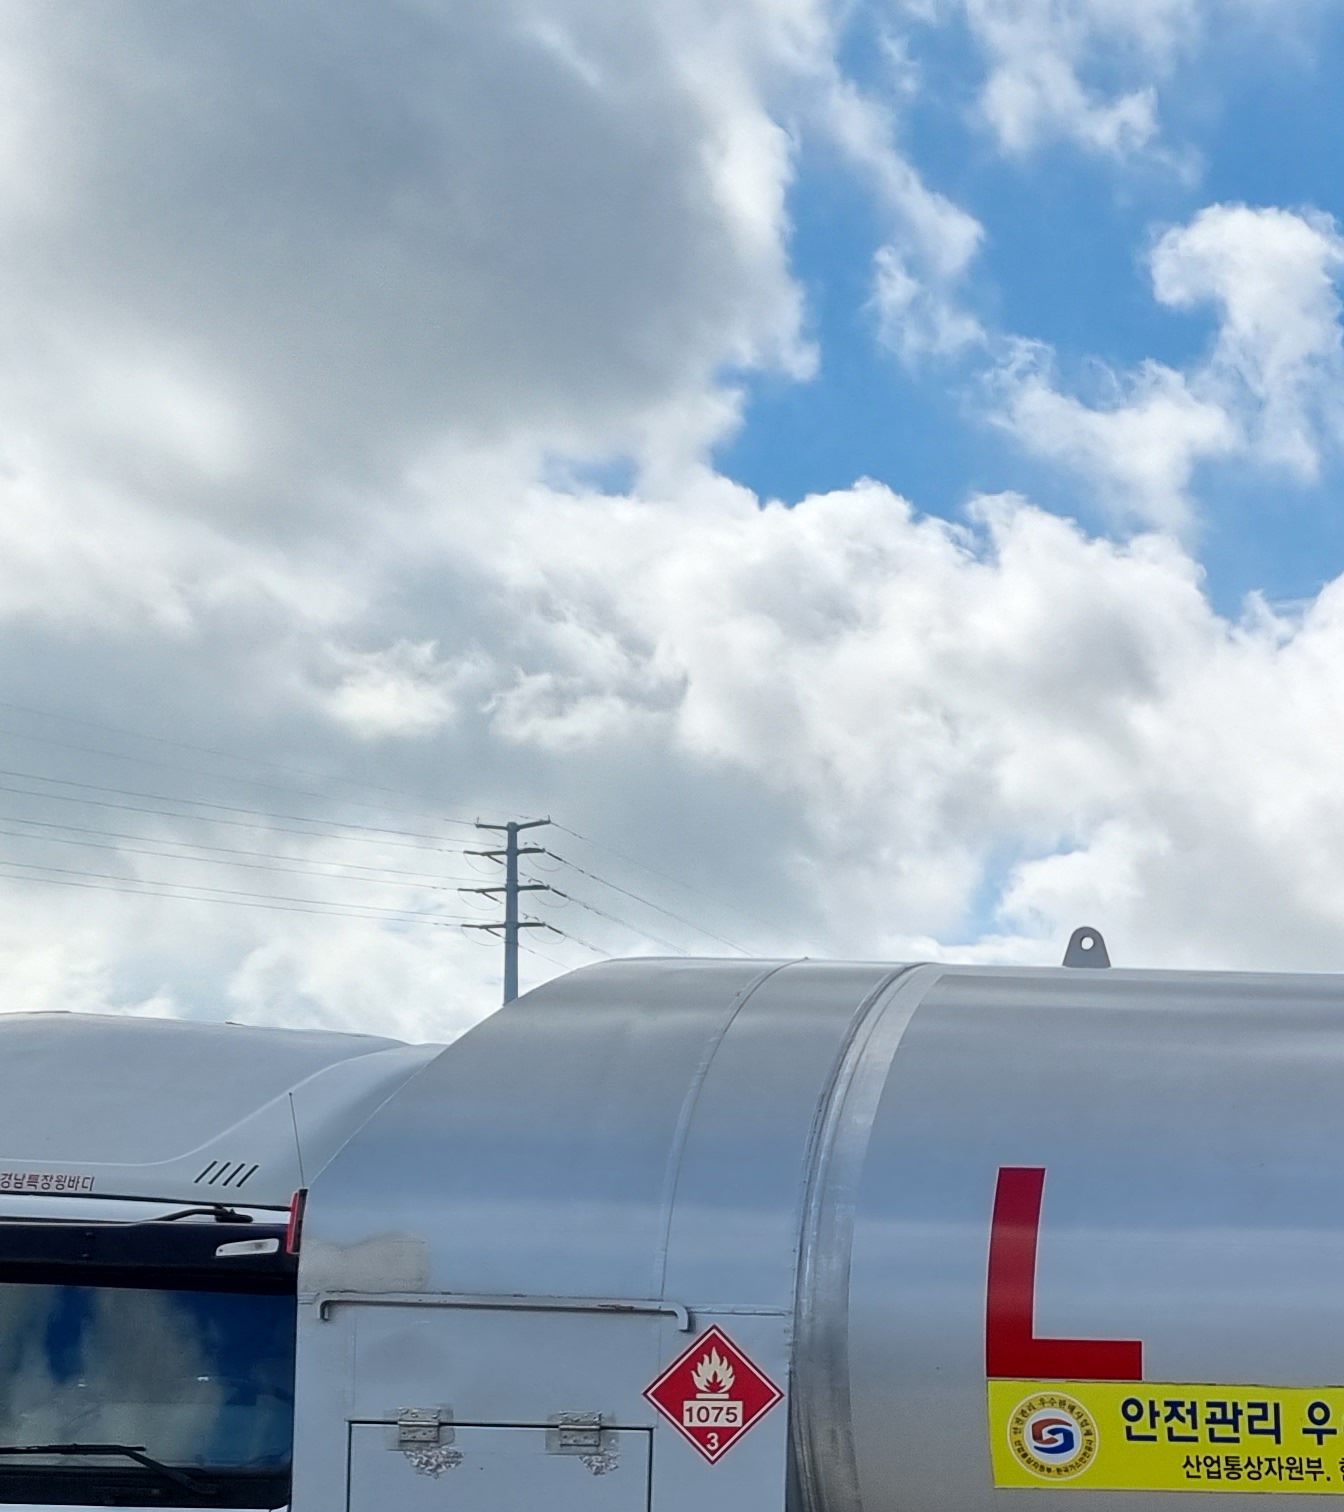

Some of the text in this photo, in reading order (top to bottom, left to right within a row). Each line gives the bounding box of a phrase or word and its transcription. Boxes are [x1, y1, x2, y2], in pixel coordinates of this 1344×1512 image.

[685, 1405, 738, 1424] 1075
[1121, 1397, 1282, 1445] 안전관리
[706, 1431, 720, 1451] 3
